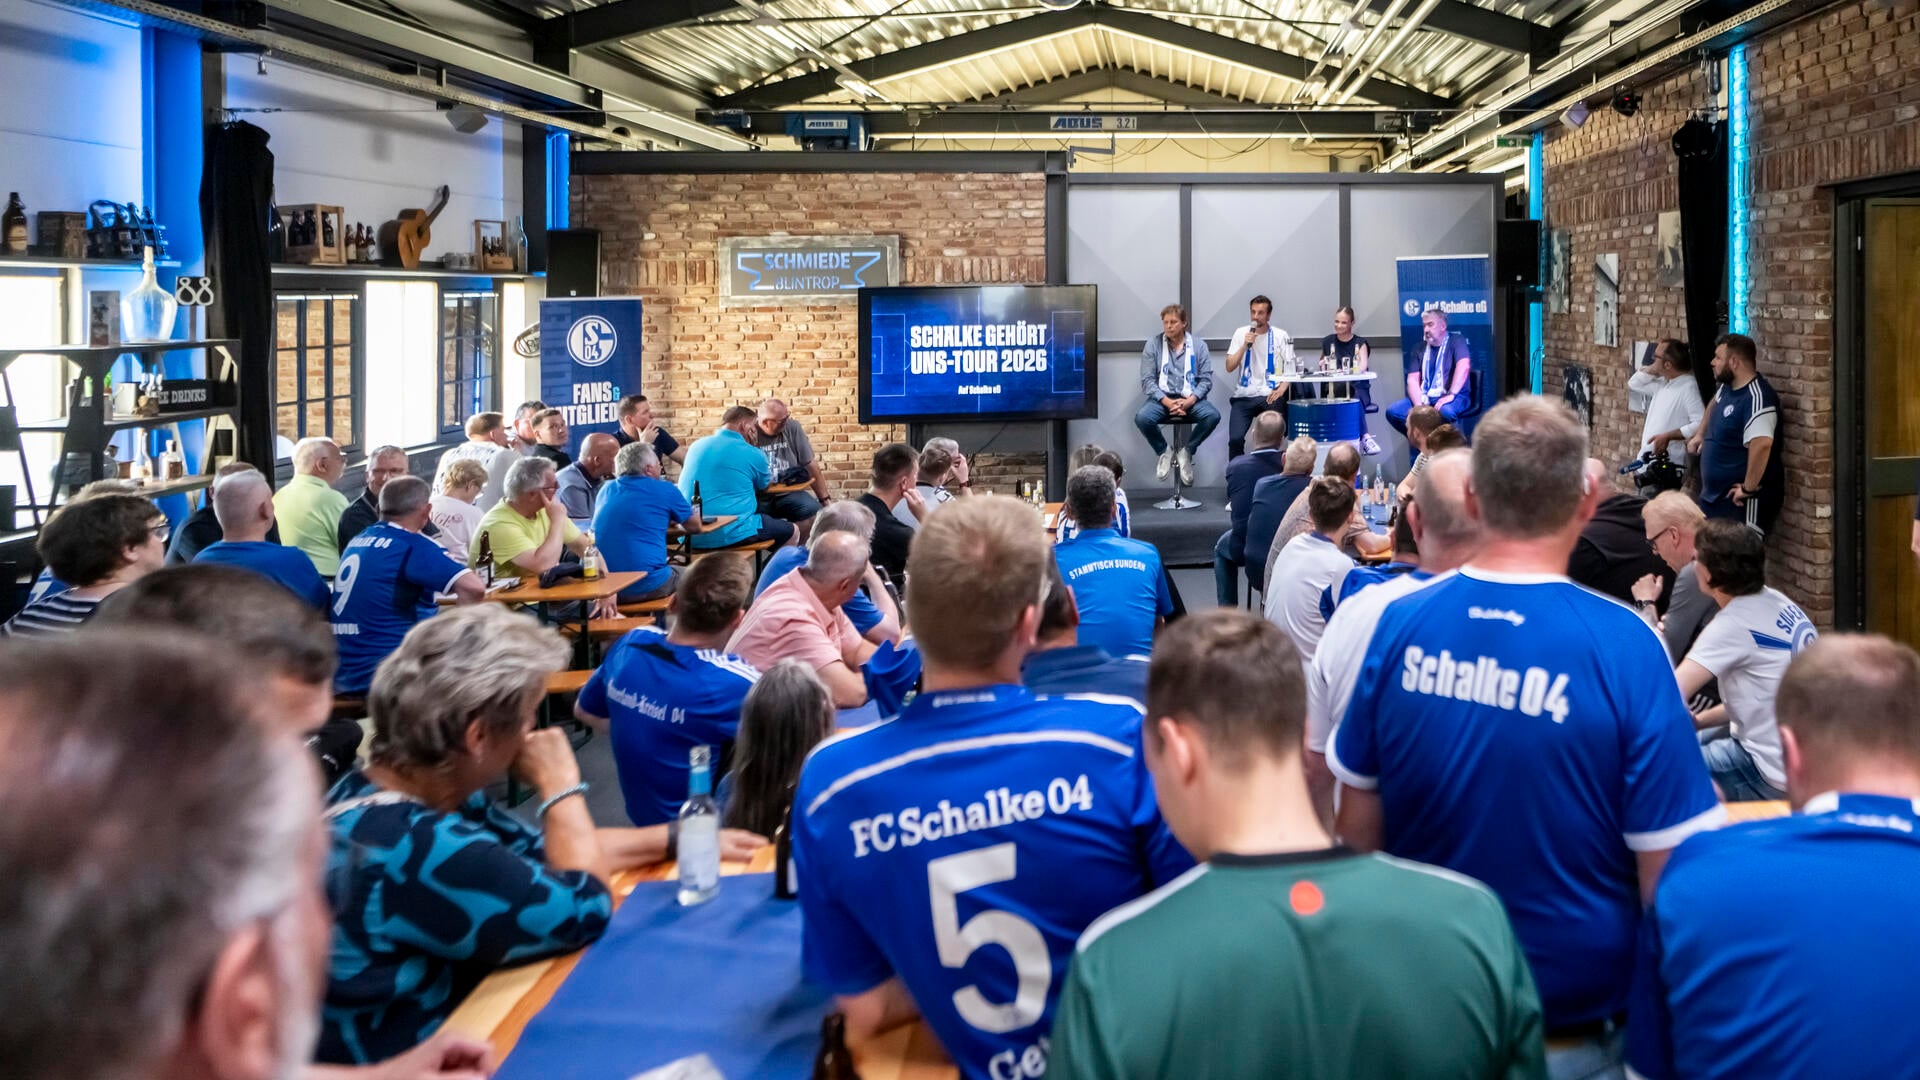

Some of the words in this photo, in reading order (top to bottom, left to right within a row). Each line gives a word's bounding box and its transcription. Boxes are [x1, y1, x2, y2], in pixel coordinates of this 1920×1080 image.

[1053, 117, 1103, 129] ABUS
[764, 252, 851, 271] SCHMIEDE
[775, 276, 840, 291] BLINTROP
[1440, 300, 1474, 313] Schalke
[910, 324, 983, 348] SCHALKE
[985, 320, 1047, 346] GEHÖRT
[910, 350, 998, 374] UNS-TOUR
[1001, 349, 1047, 372] 2026
[171, 389, 207, 403] DRINKS
[1069, 560, 1114, 580] STAMMTISCH
[1115, 560, 1146, 572] SUNDERN
[333, 554, 360, 616] 9
[1402, 645, 1520, 710] Schalke
[1519, 667, 1570, 724] 04
[850, 813, 897, 858] FC
[898, 787, 1046, 847] Schalke
[1047, 774, 1094, 815] 04
[927, 841, 1052, 1034] 5
[989, 1034, 1051, 1080] Ge
